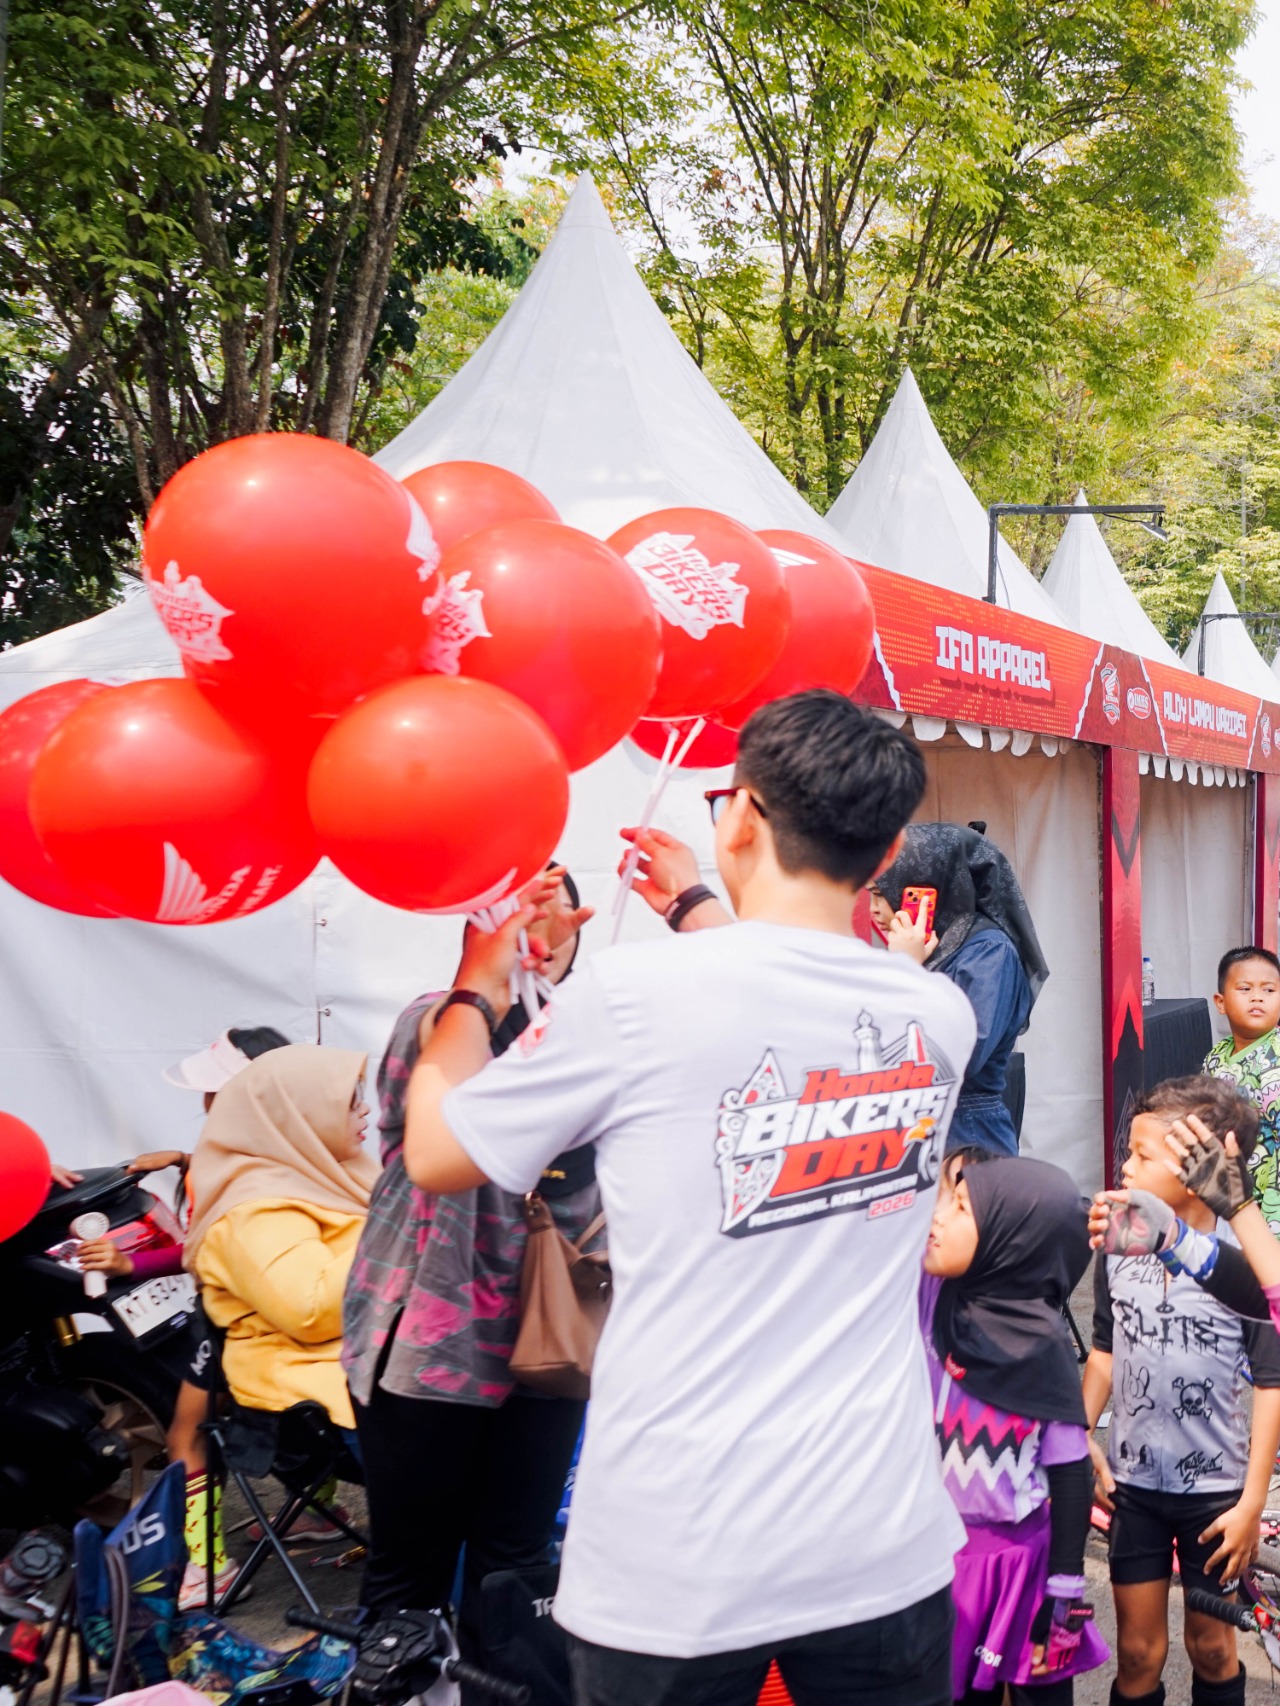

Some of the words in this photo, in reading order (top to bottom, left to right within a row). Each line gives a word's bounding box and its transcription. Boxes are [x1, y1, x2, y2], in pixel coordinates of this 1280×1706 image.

[936, 626, 974, 675] IFO
[977, 635, 1051, 692] APPAREL
[1163, 691, 1187, 724] ALDY
[1188, 697, 1215, 731] LAMPU
[798, 1060, 936, 1105] Honda
[733, 1084, 952, 1158] BIKERS
[769, 1127, 911, 1198] DAY
